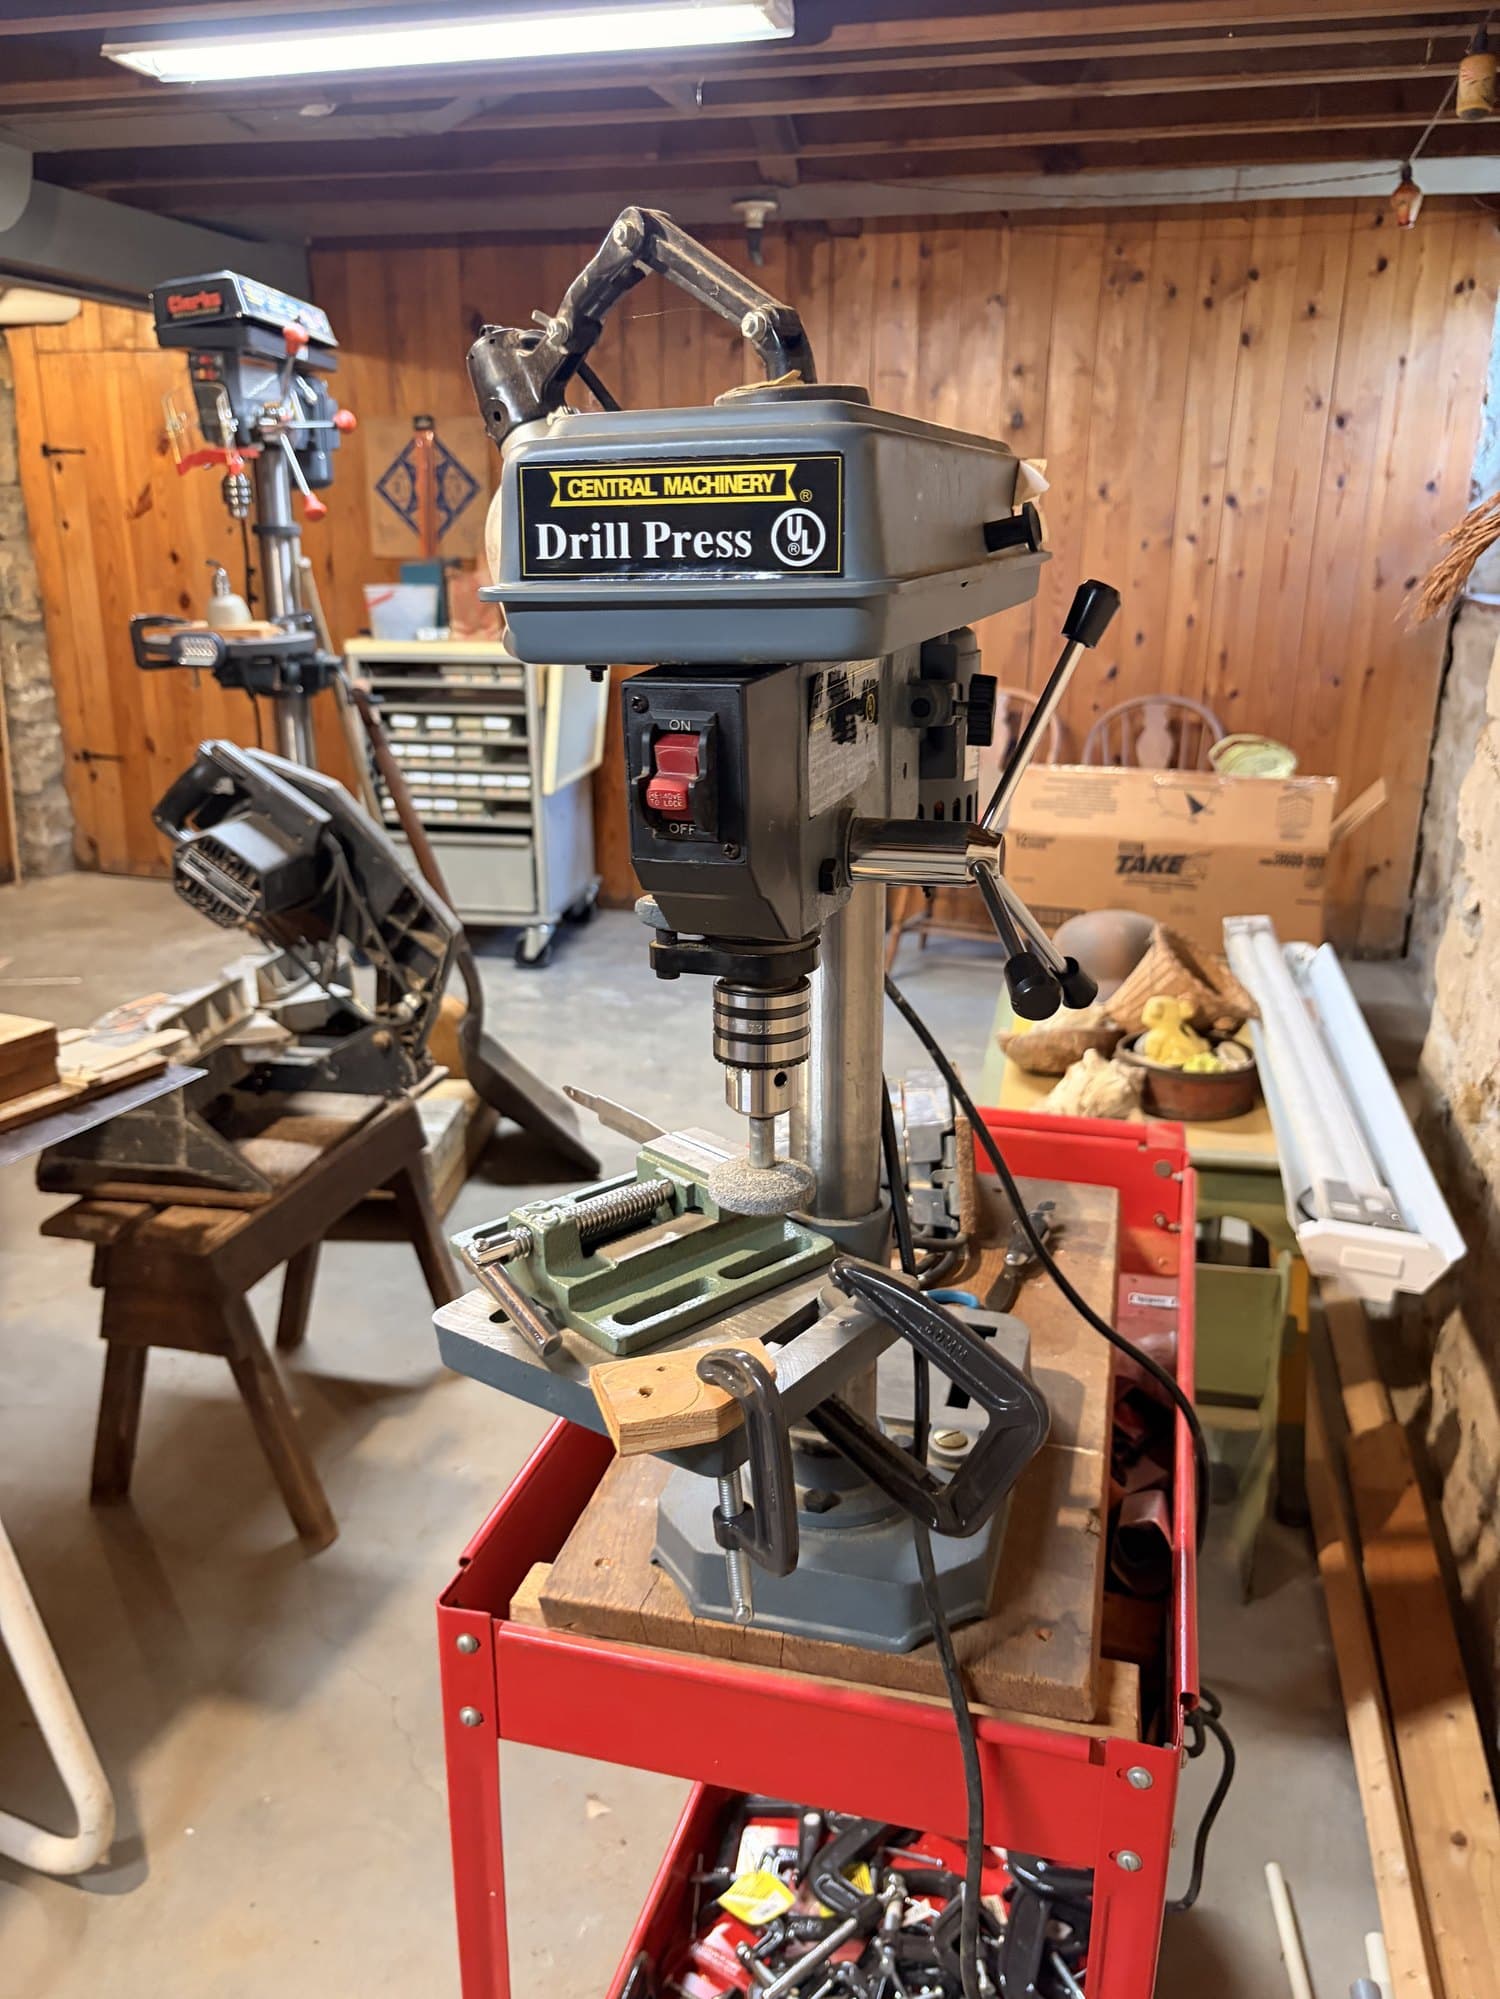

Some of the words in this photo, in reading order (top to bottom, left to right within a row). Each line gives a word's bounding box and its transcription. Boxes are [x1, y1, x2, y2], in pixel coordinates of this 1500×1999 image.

[567, 477, 658, 498] CENTRAL
[663, 473, 776, 496] MACHINERY
[535, 522, 632, 560] Drill
[642, 521, 752, 559] Press
[669, 719, 691, 731] ON
[669, 823, 696, 835] OFF
[1115, 855, 1186, 874] TAKE
